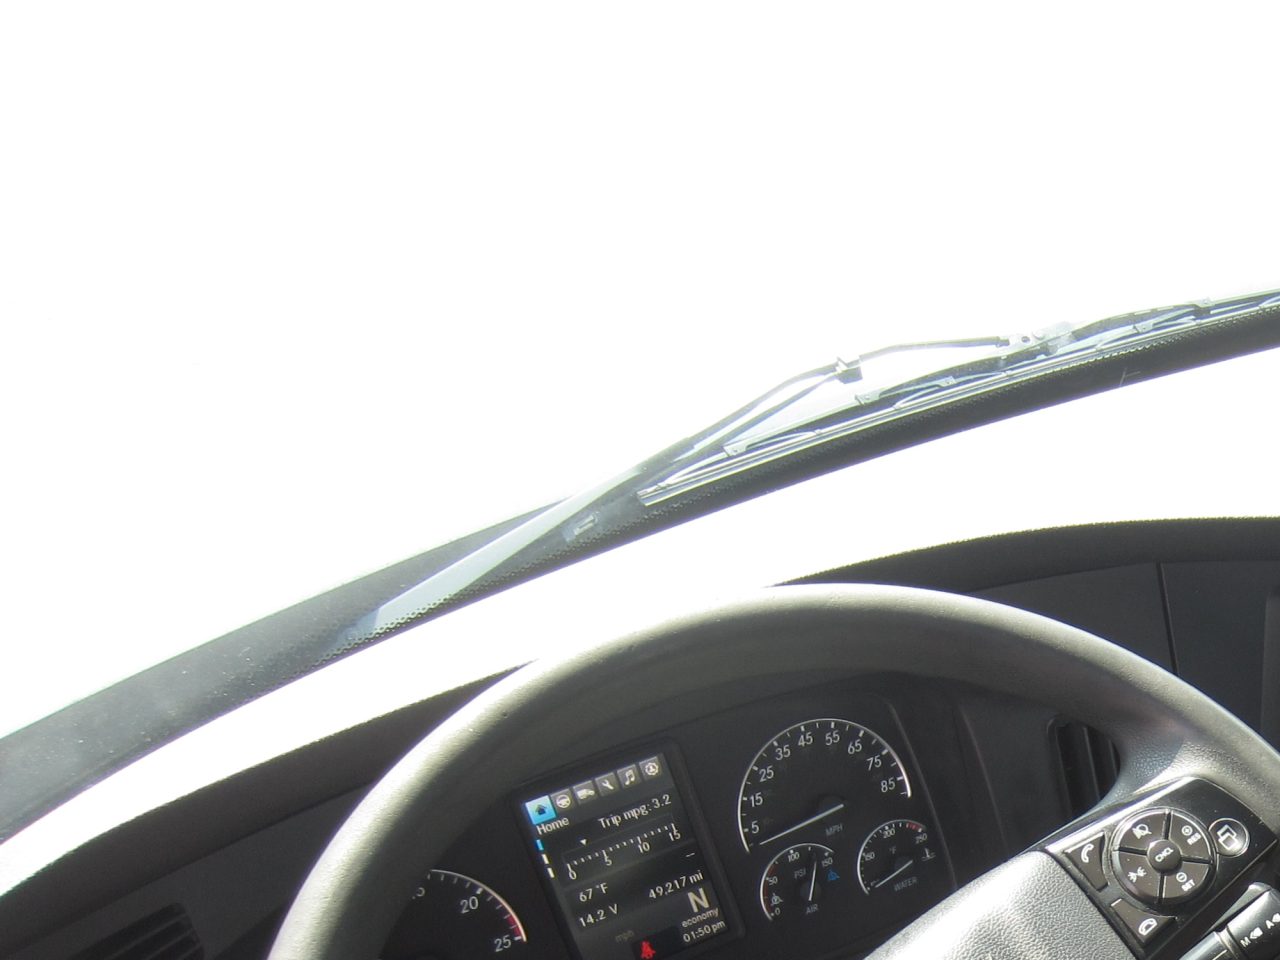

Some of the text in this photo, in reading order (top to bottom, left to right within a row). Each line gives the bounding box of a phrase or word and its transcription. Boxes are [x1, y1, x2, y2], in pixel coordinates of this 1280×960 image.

[797, 732, 813, 747] 45
[825, 731, 840, 746] 55
[775, 746, 791, 760] 35
[847, 740, 863, 755] 65
[866, 757, 882, 771] 75
[759, 766, 774, 782] 25
[880, 777, 896, 792] 85
[750, 793, 764, 808] 15
[599, 794, 672, 829] Trip mpg: 3.2
[536, 816, 570, 835] Home
[751, 821, 760, 834] 5
[669, 831, 681, 842] 15
[638, 841, 650, 854] 10
[605, 857, 613, 867] 5
[787, 851, 800, 863] 100
[568, 870, 577, 881] 0
[689, 870, 704, 884] mi
[768, 876, 778, 886] 50
[579, 888, 594, 902] 67
[688, 888, 711, 913] N
[460, 896, 479, 914] 20
[579, 903, 619, 928] 14.2 V
[681, 907, 719, 928] economy
[683, 920, 726, 943] 01:50 pm
[494, 935, 512, 952] 25
